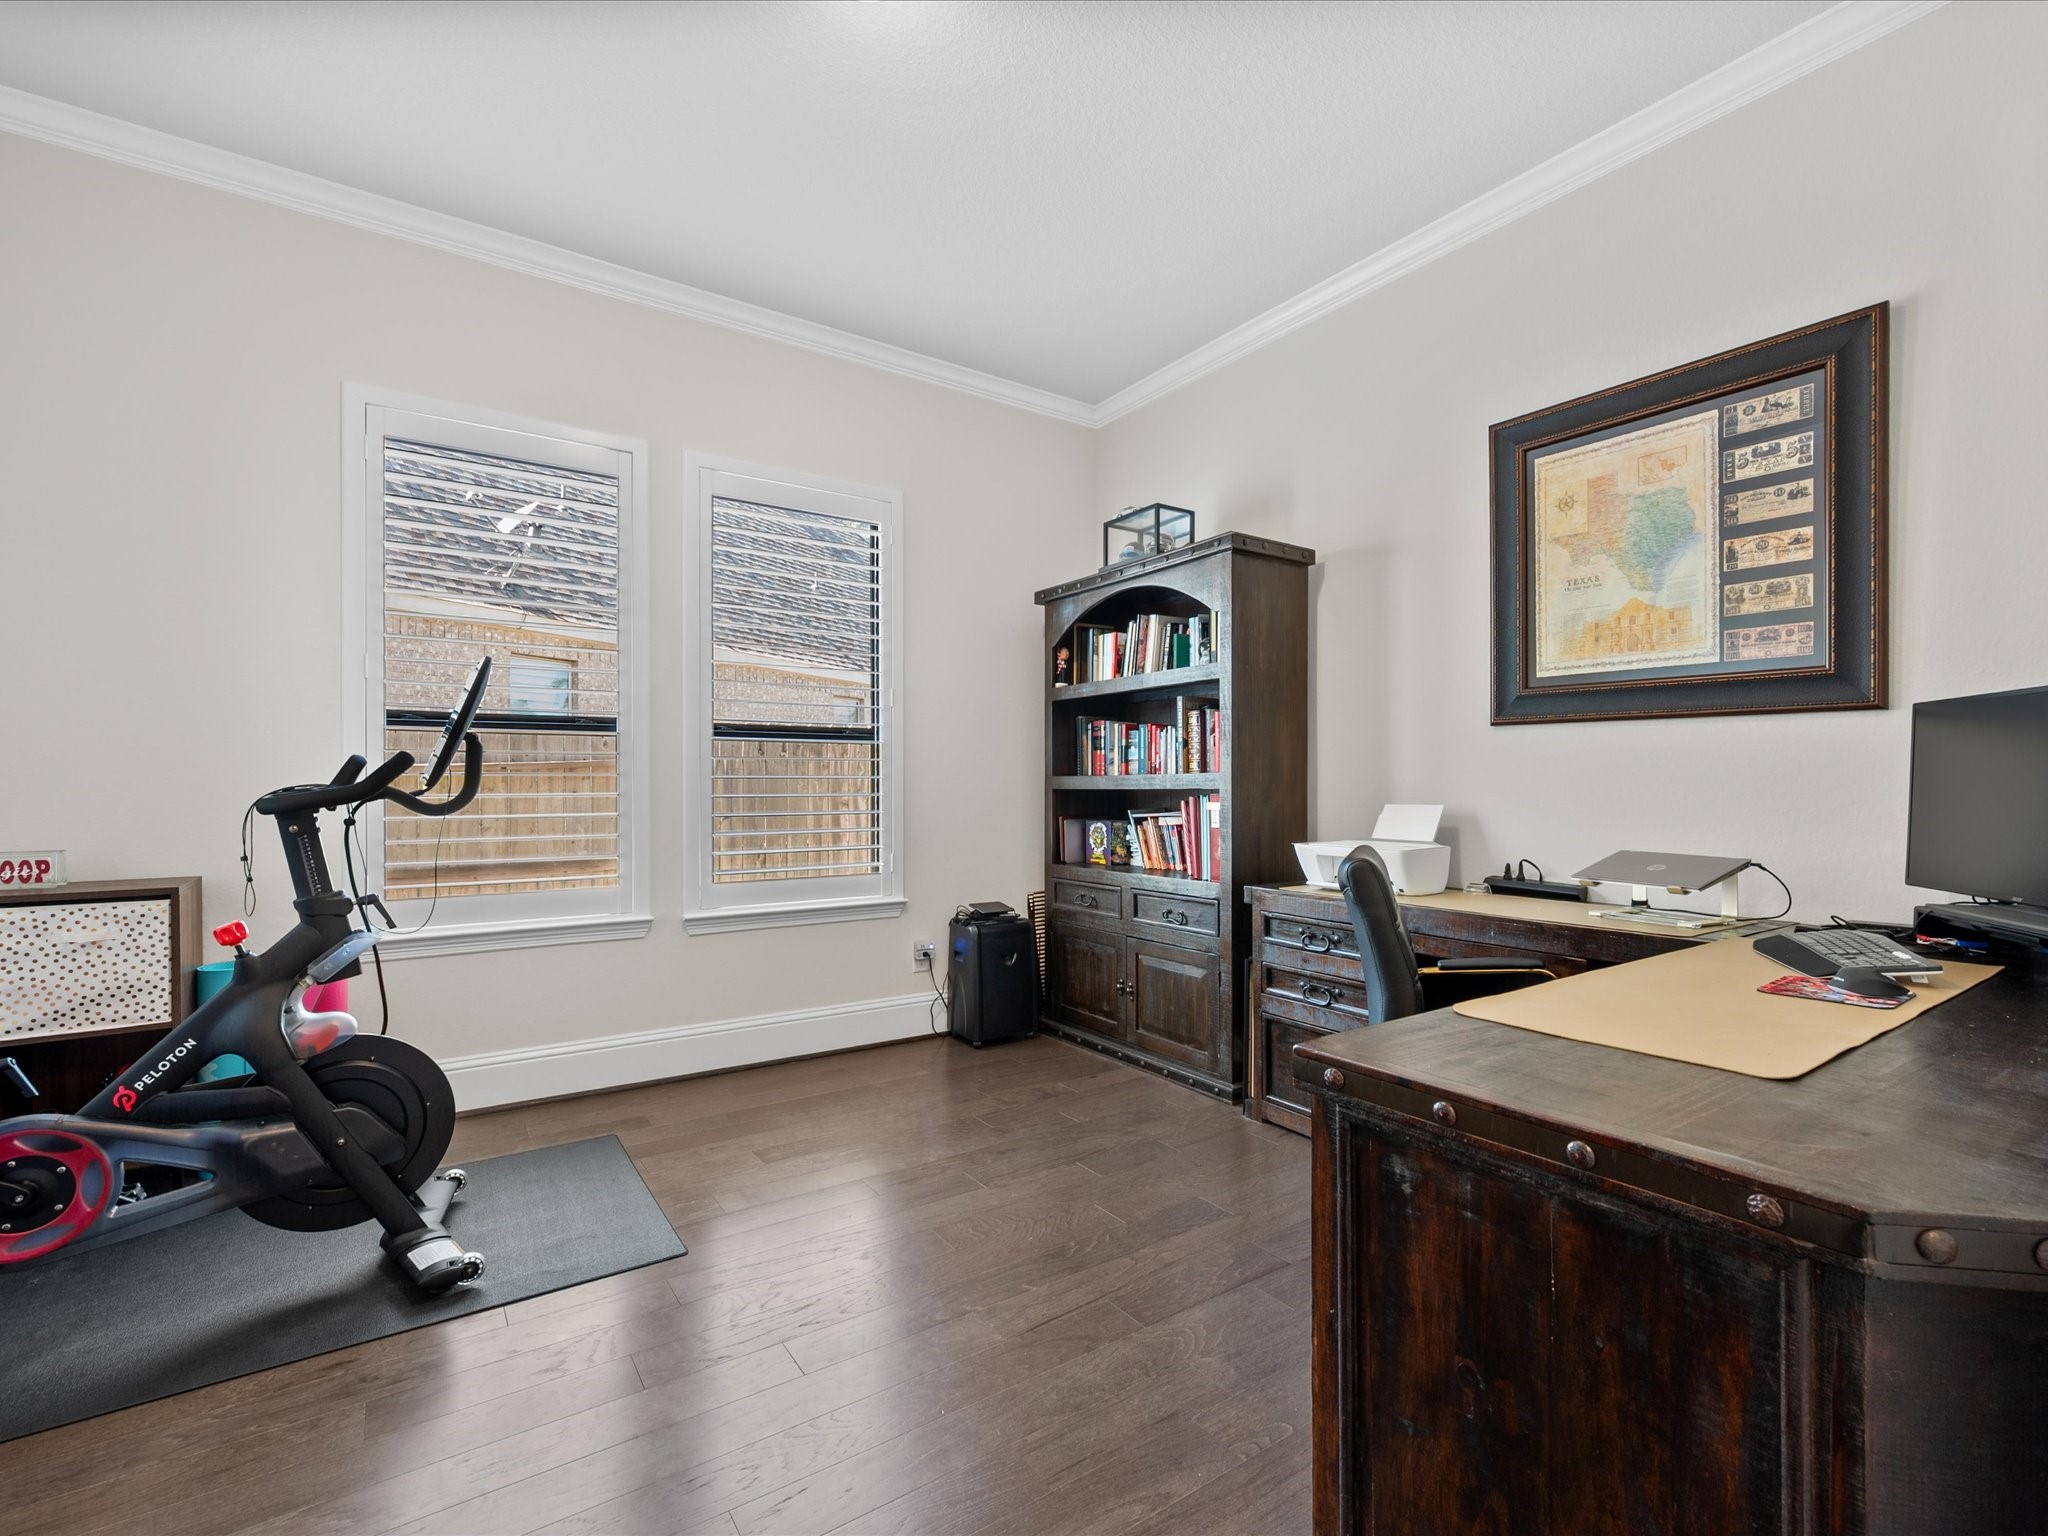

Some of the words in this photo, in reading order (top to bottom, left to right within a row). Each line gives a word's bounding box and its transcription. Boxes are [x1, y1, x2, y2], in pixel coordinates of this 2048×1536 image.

[1785, 440, 1798, 459] 5
[1566, 575, 1600, 587] TEXAS
[134, 1038, 198, 1091] PELOTON
